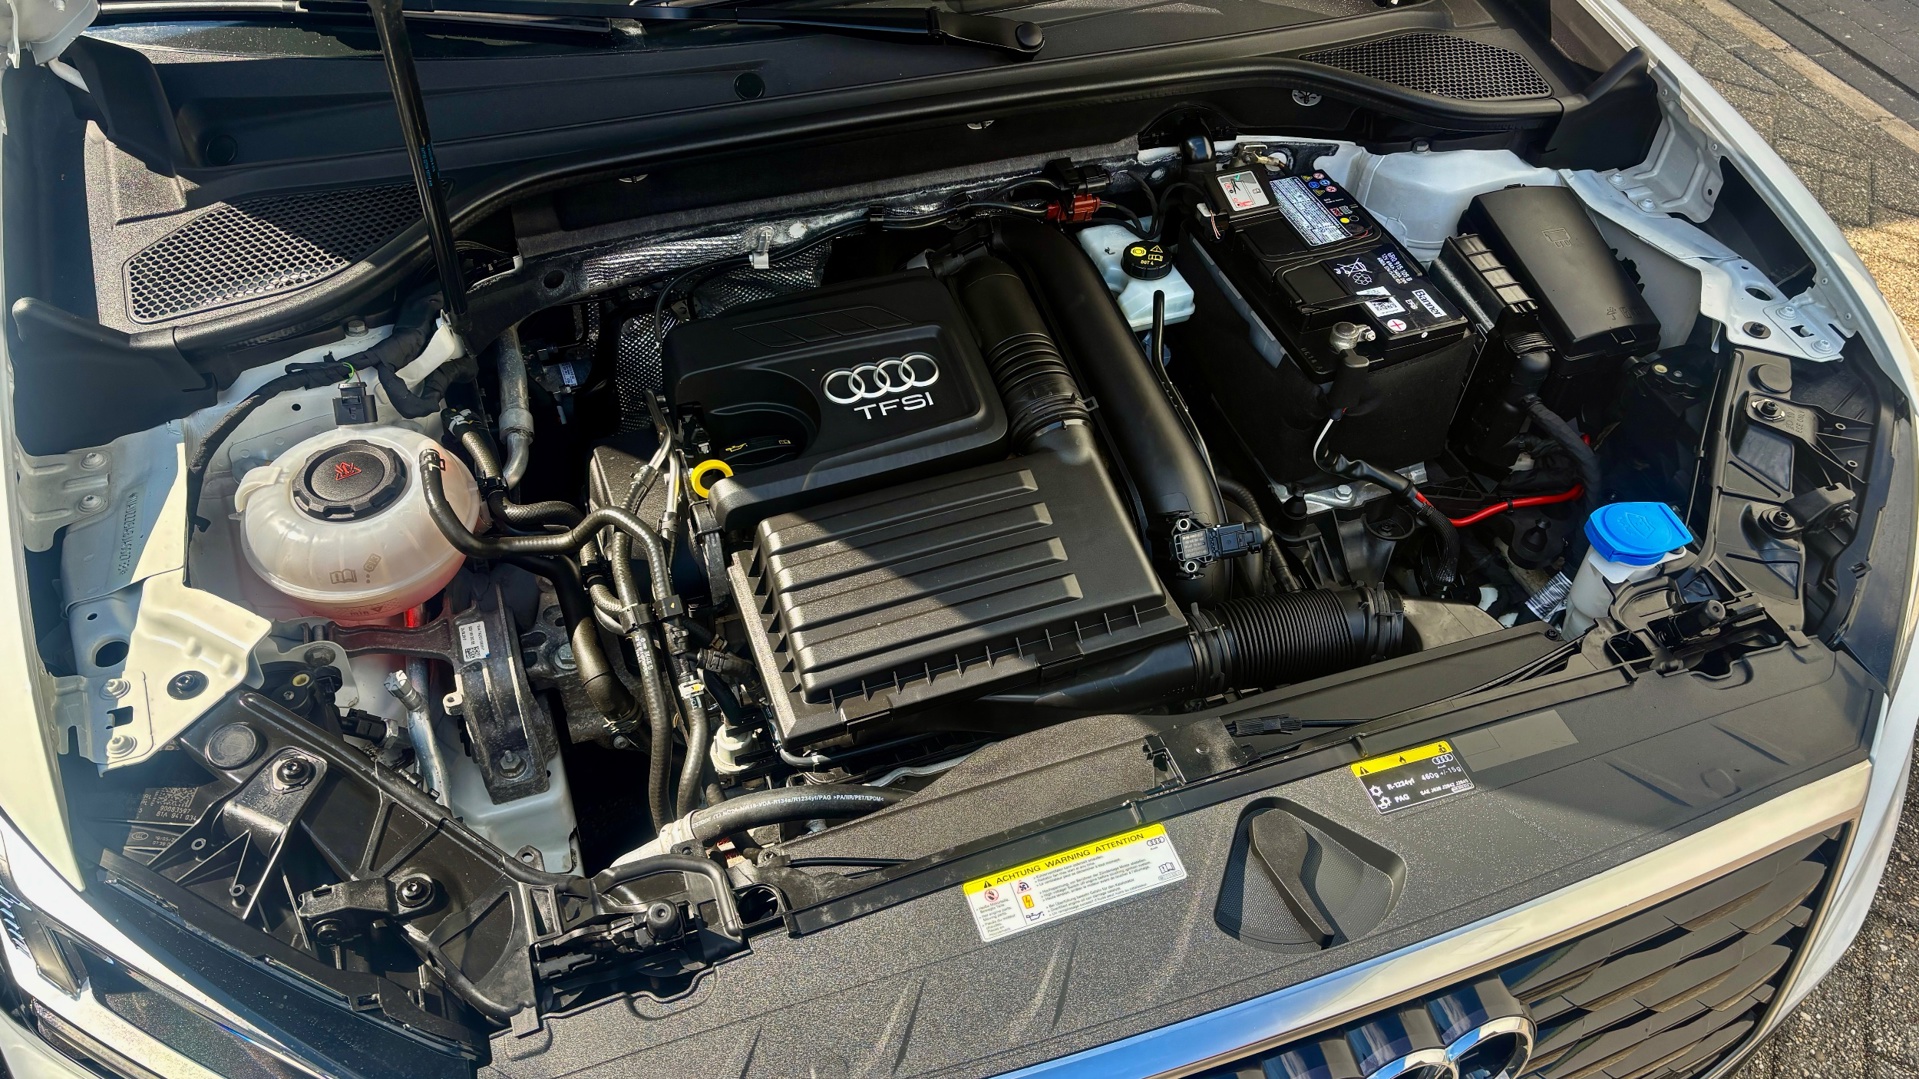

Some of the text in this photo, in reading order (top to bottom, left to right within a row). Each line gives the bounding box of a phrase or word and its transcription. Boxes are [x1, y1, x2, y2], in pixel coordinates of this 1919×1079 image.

[1414, 290, 1443, 317] Banner
[853, 392, 935, 420] TFSI
[1394, 794, 1411, 803] PAG
[996, 865, 1041, 884] ACHTUNG
[1045, 850, 1091, 868] WARNING
[1095, 833, 1144, 853] ATTENTION
